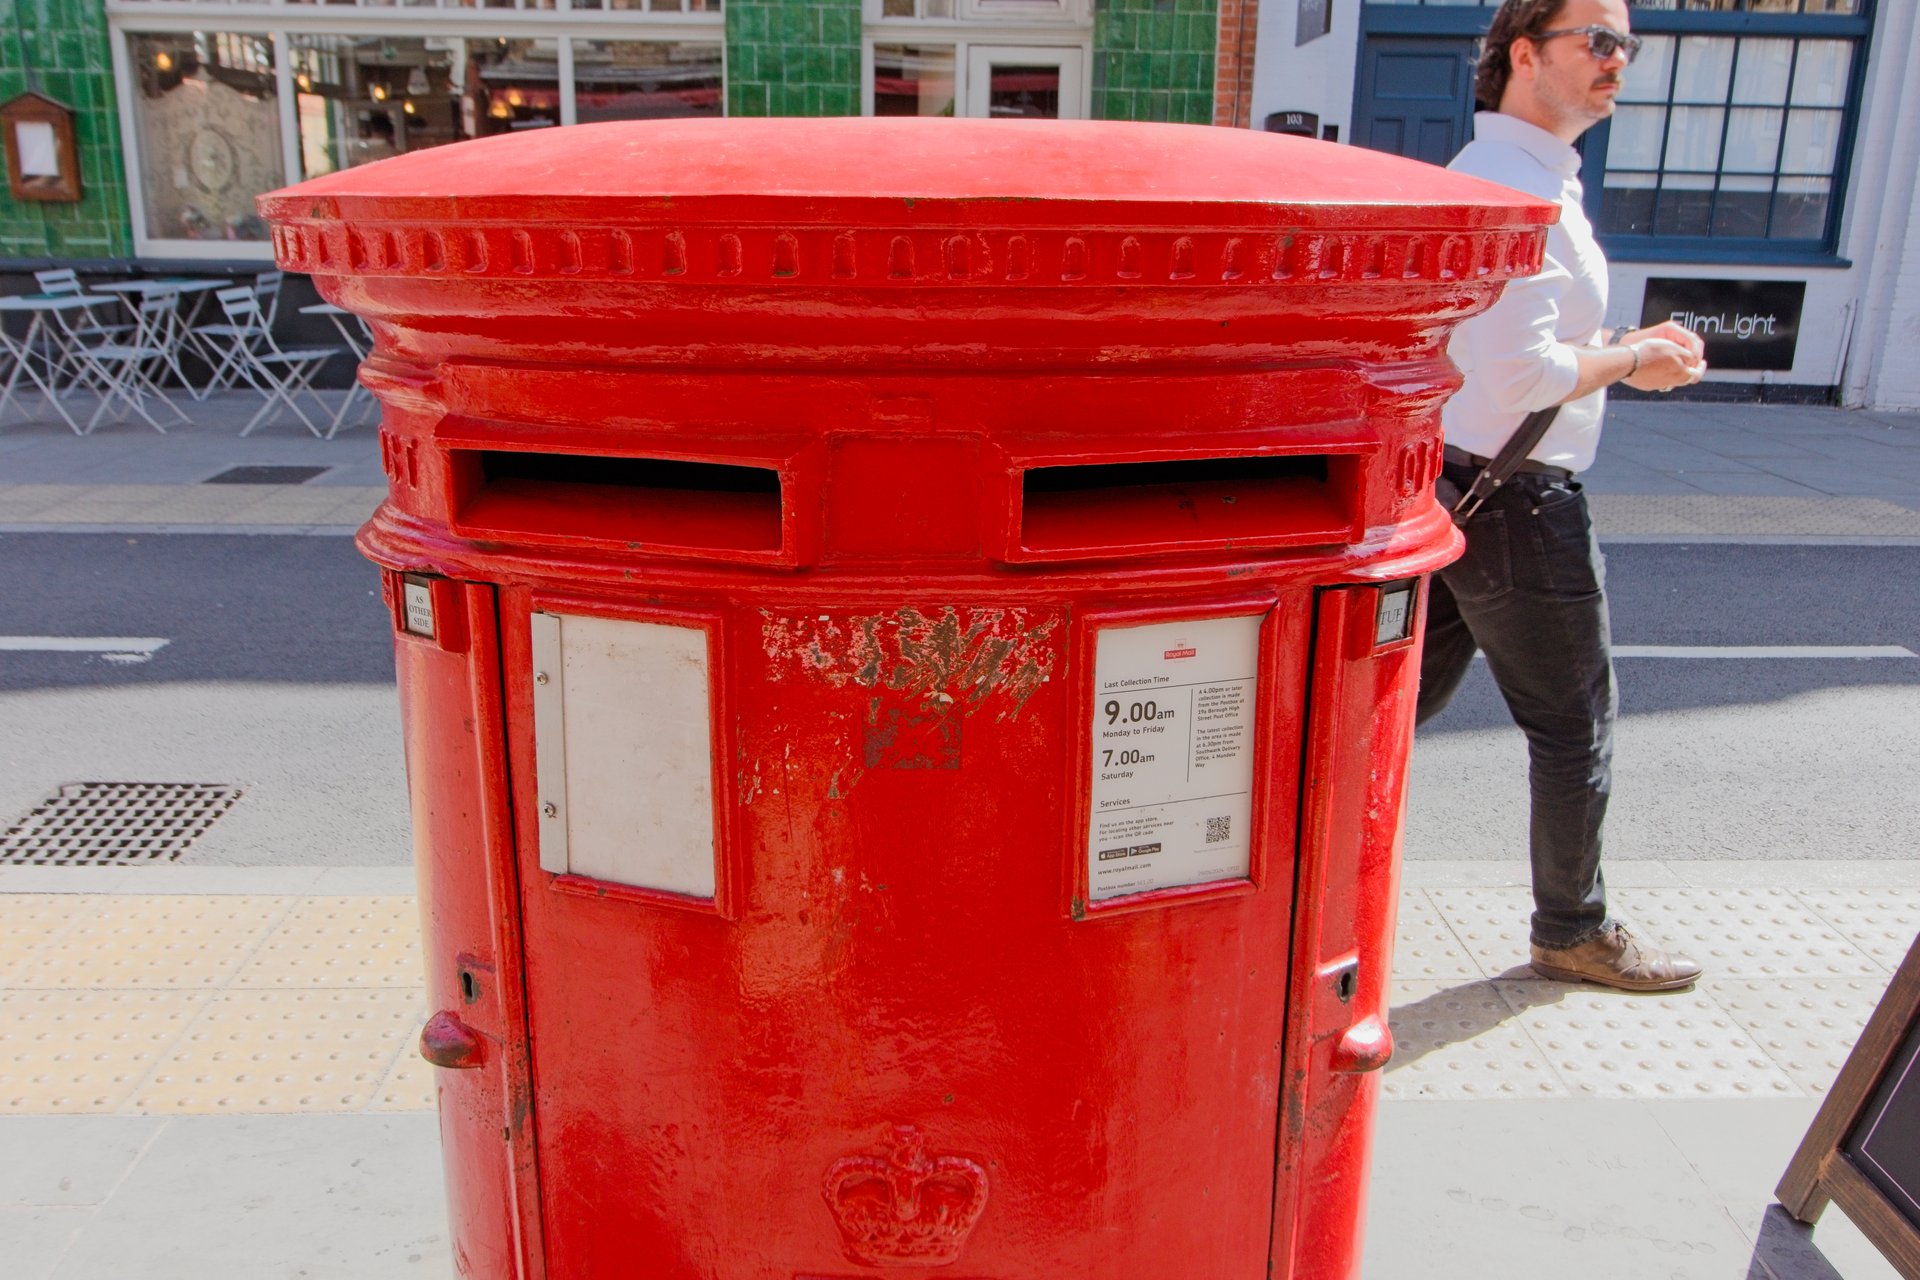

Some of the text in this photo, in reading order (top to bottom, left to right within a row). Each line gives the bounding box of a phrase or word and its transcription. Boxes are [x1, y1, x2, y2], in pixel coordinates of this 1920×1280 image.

[1286, 113, 1302, 125] 103
[415, 596, 423, 604] AS
[408, 604, 432, 617] OTHER
[413, 616, 430, 628] SIDE
[1104, 681, 1119, 689] Last
[1120, 678, 1152, 687] Collection
[1105, 700, 1175, 725] 9.00am
[1102, 730, 1130, 738] Monday
[1143, 725, 1165, 733] Friday
[1102, 749, 1155, 767] 7.00am
[1101, 771, 1133, 780] Saturday
[1100, 798, 1130, 807] Services
[1098, 863, 1151, 875] www.royalmail.com
